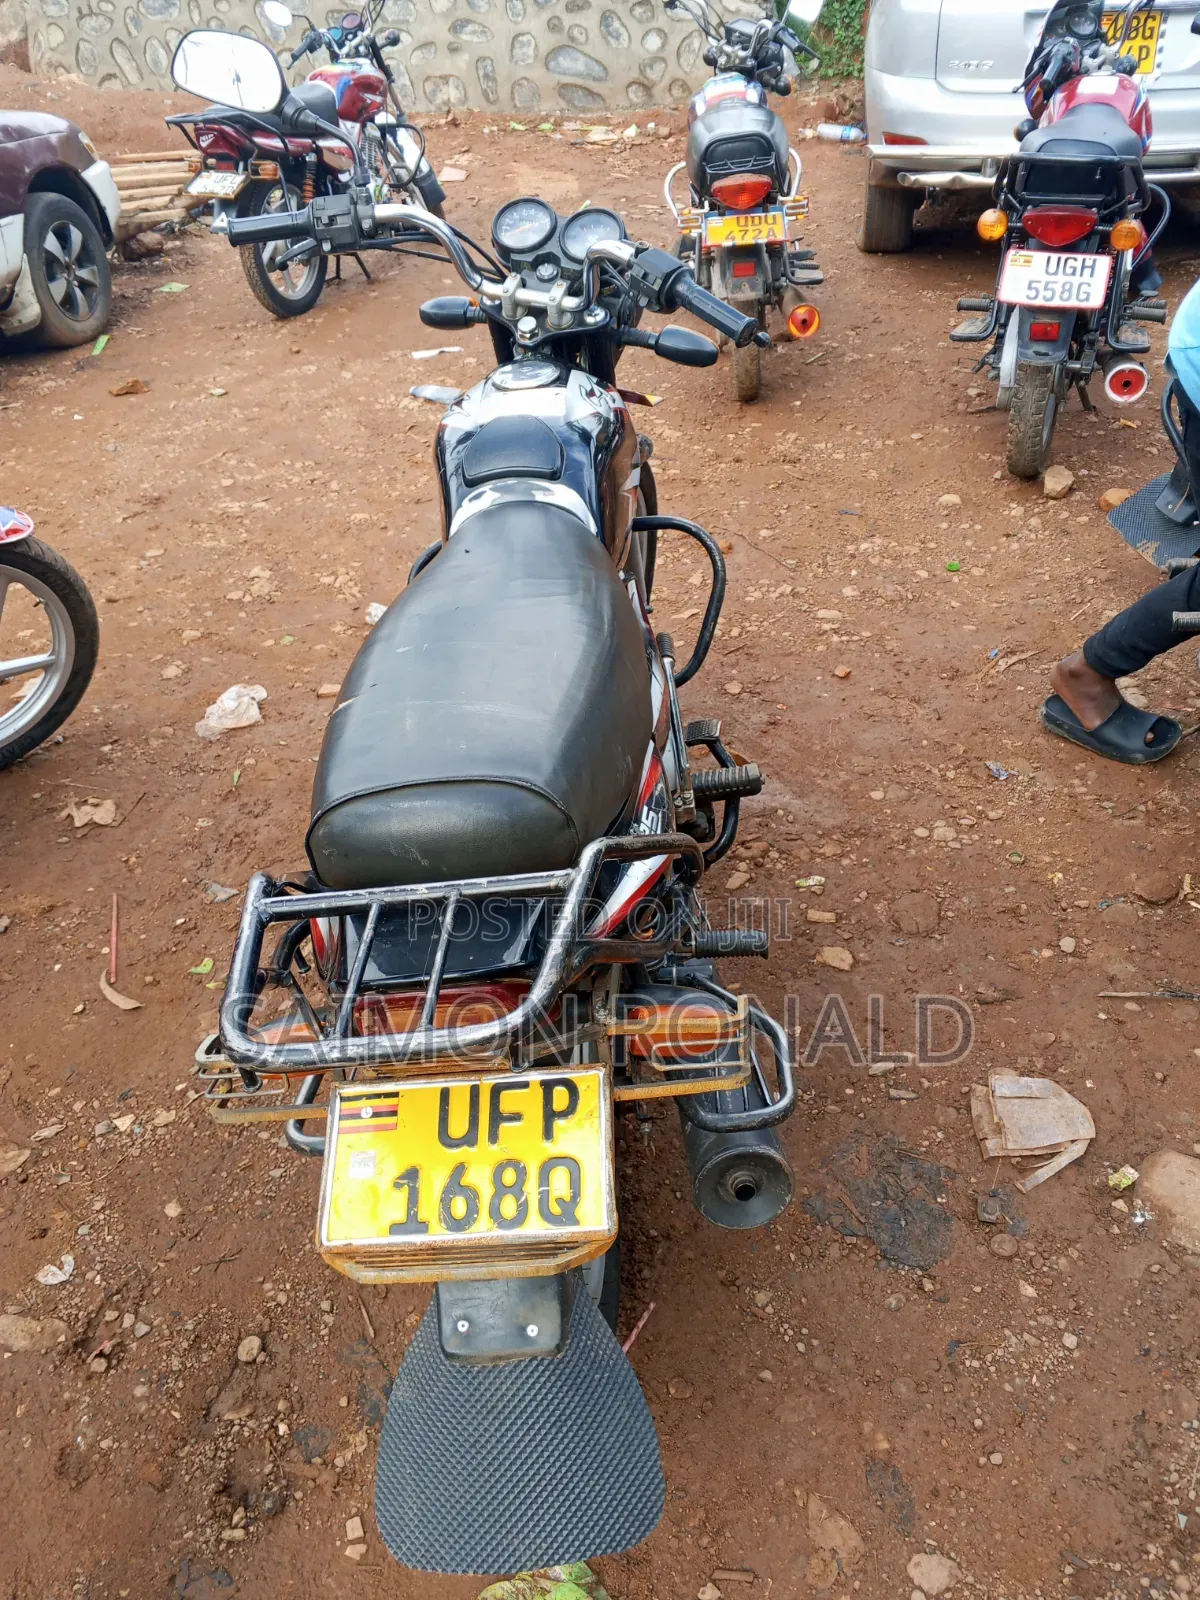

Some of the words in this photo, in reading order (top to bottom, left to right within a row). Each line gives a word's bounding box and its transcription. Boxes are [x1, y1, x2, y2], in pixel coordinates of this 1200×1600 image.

[724, 228, 778, 241] 472A
[1045, 255, 1098, 278] UGH
[1025, 279, 1092, 303] 558G
[438, 1077, 580, 1150] UFP
[388, 1156, 582, 1236] 168Q
